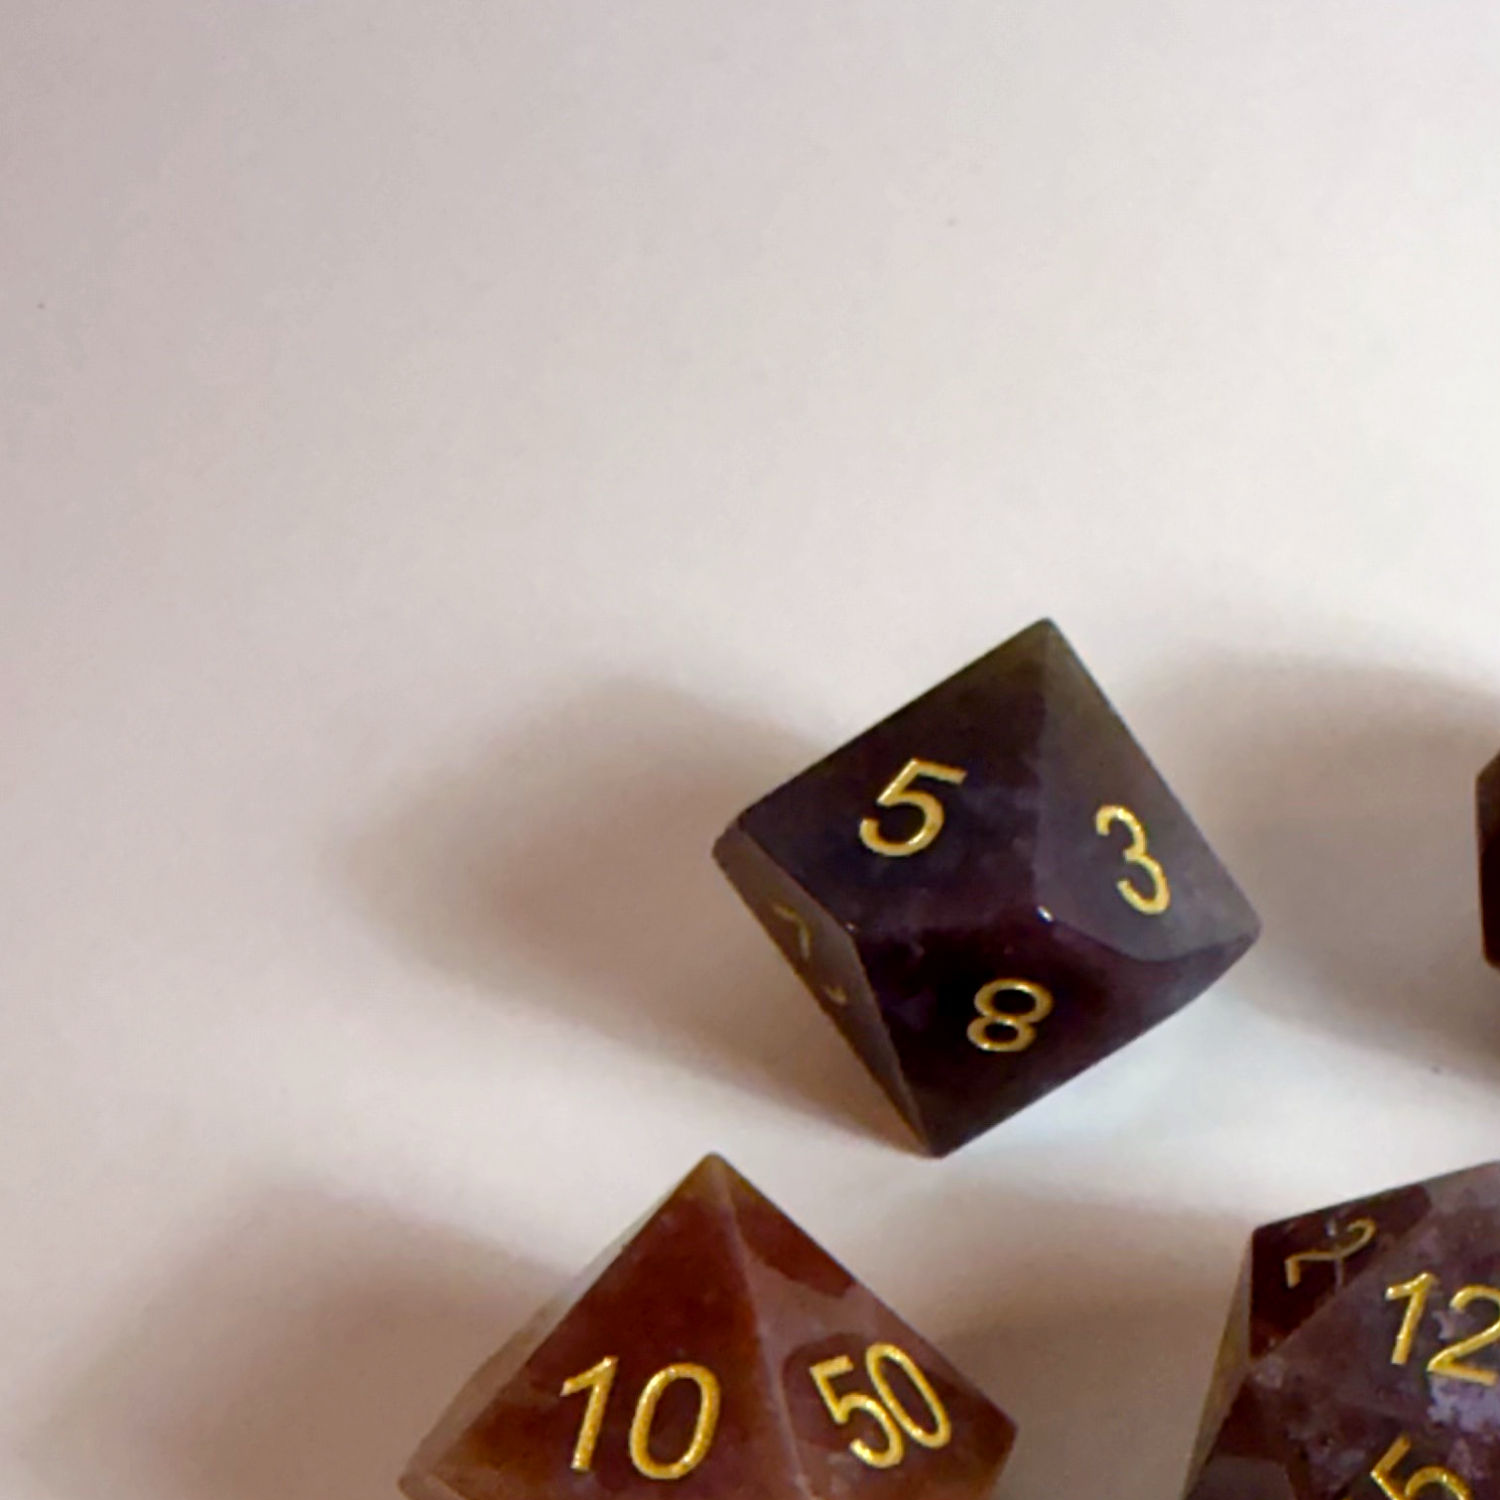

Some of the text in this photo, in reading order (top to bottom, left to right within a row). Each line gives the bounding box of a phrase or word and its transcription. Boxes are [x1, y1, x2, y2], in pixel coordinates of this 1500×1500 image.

[859, 757, 967, 857] 5
[1095, 805, 1171, 915] 3
[966, 978, 1053, 1053] 8
[1285, 1218, 1376, 1288] 2
[560, 1356, 720, 1480] 10
[810, 1342, 951, 1469] 50
